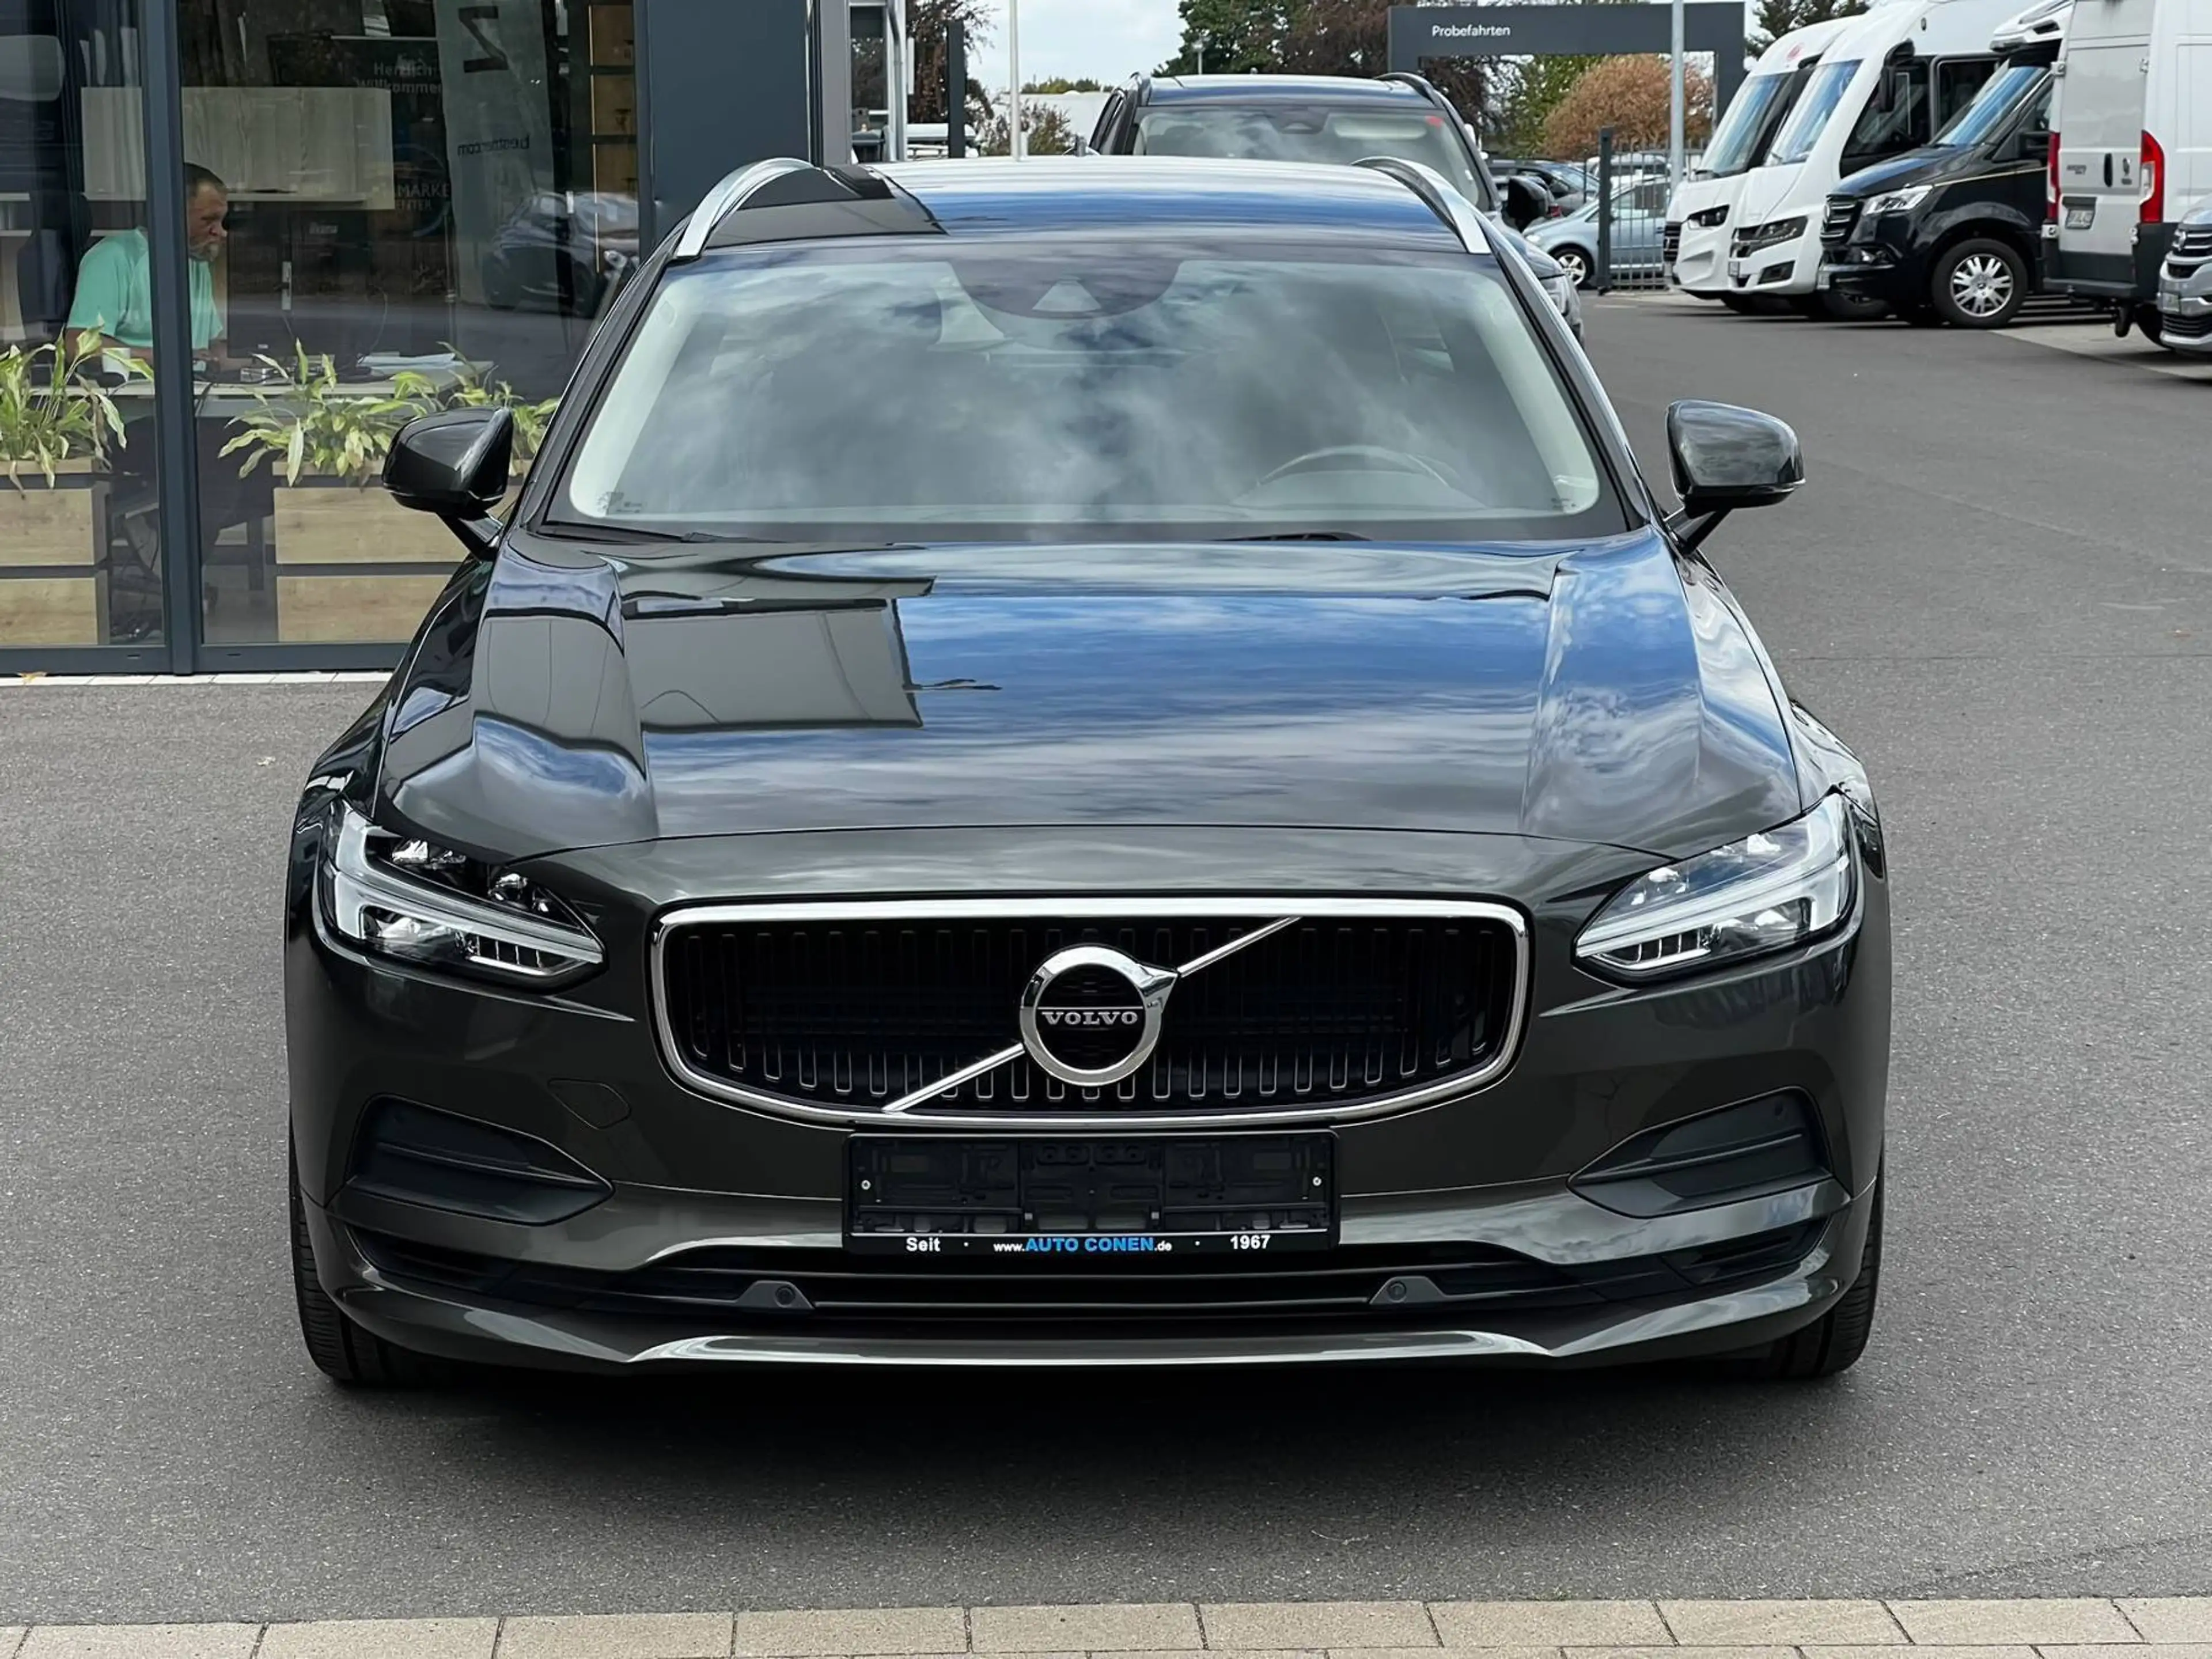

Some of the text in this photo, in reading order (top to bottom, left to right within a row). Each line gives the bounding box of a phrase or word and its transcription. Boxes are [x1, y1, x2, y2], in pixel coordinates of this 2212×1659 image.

[1432, 24, 1510, 36] Probefahrten
[397, 183, 449, 197] MARKE
[1041, 1012, 1138, 1025] VOLVO
[906, 1234, 1271, 1252] Seit www.AUTO CONEN.de 1967
